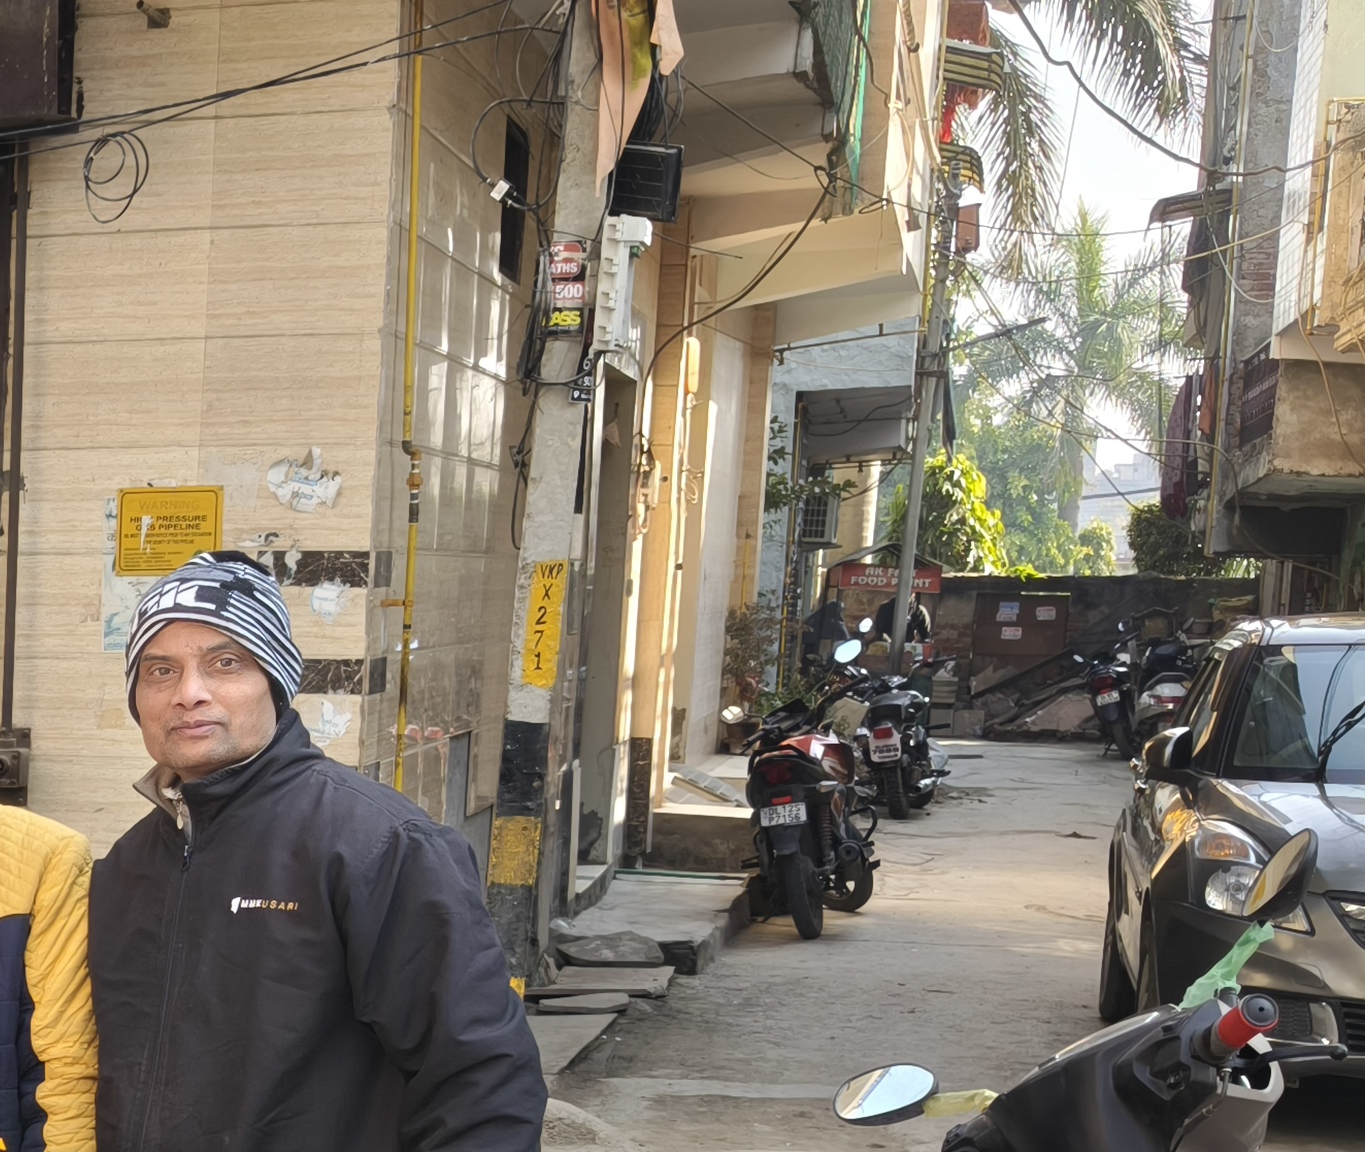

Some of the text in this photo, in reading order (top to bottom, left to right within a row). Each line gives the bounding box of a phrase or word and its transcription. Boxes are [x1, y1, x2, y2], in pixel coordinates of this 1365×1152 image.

[139, 500, 201, 511] WARNING
[156, 515, 208, 523] PRESSURE
[158, 523, 202, 531] PIPELINE
[850, 576, 887, 586] FOOD
